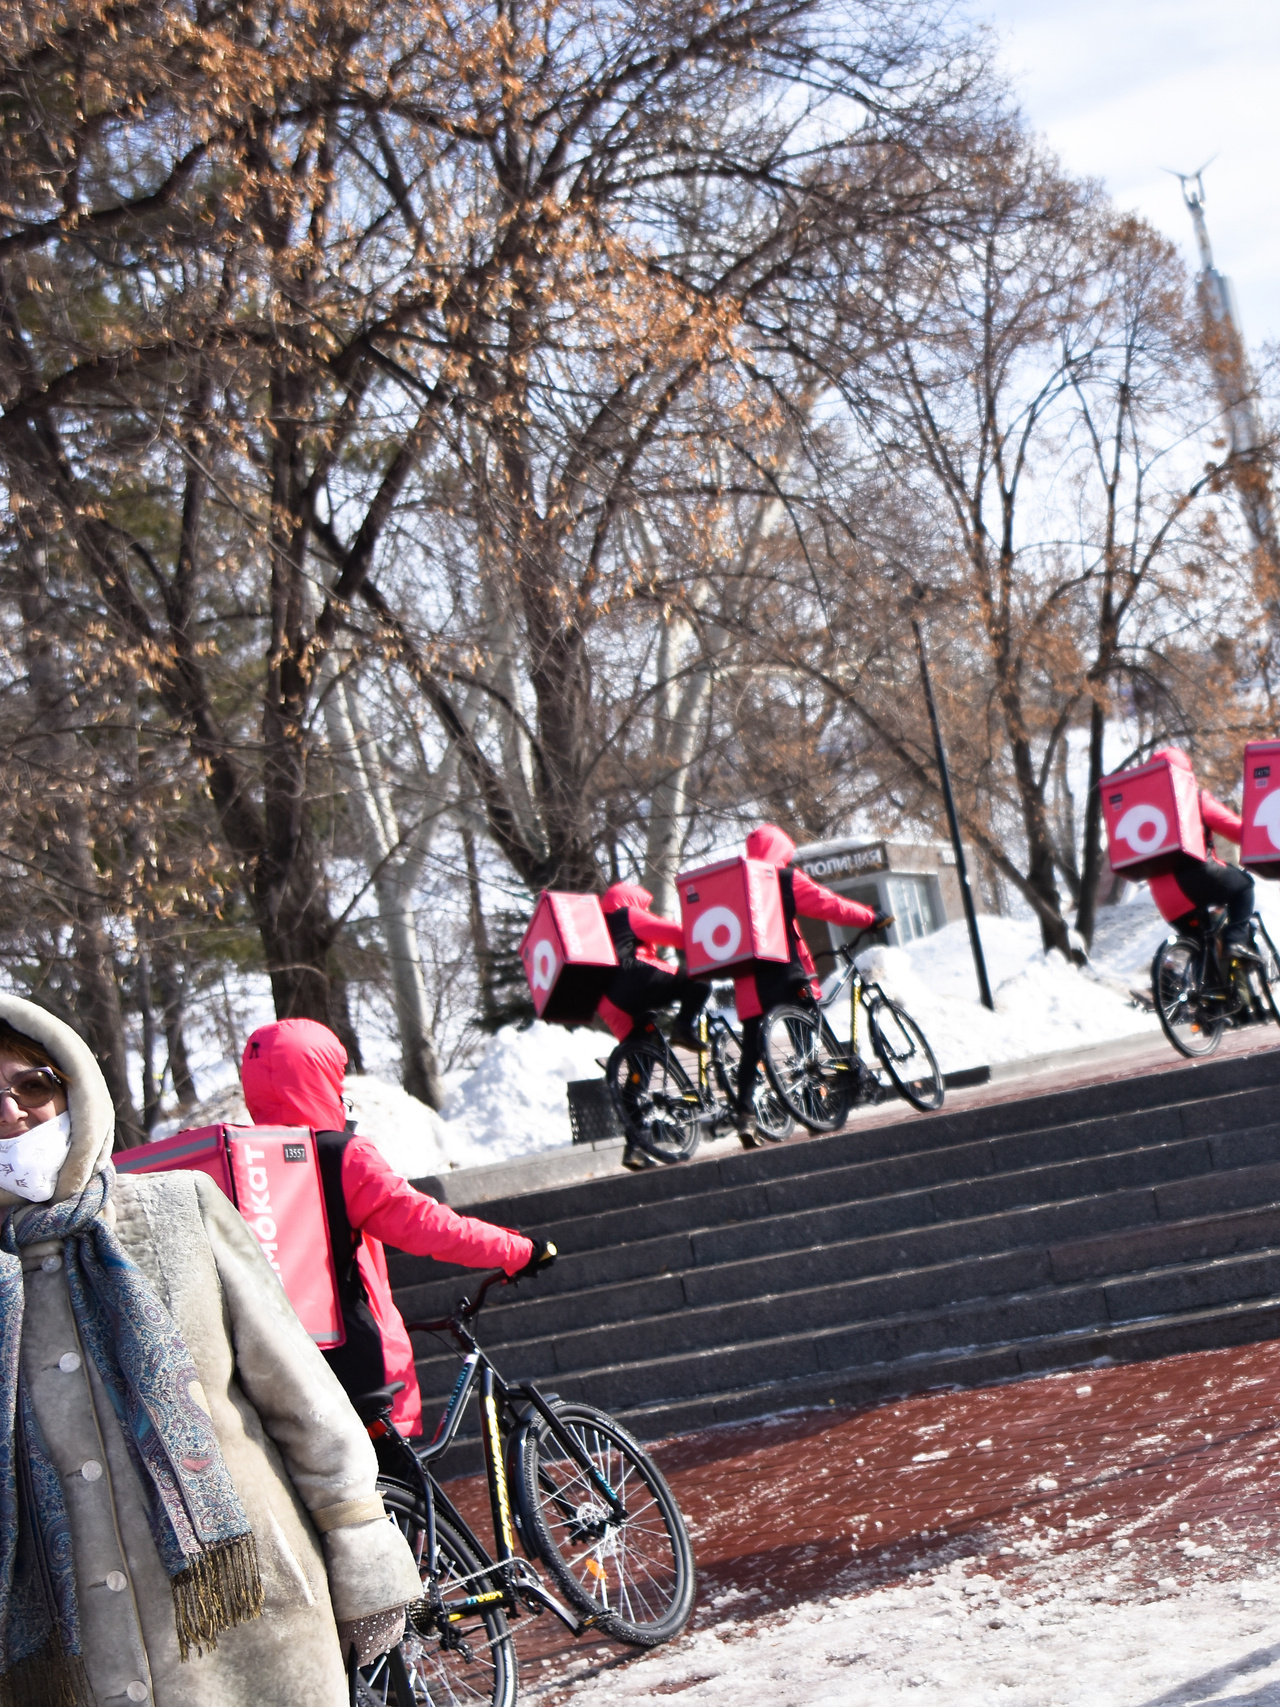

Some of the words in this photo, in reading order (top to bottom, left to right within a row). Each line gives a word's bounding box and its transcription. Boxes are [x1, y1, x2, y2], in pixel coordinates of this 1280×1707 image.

[803, 848, 882, 876] ПОЛИЦИЯ
[284, 1148, 306, 1159] 13557
[244, 1144, 284, 1287] мокат
